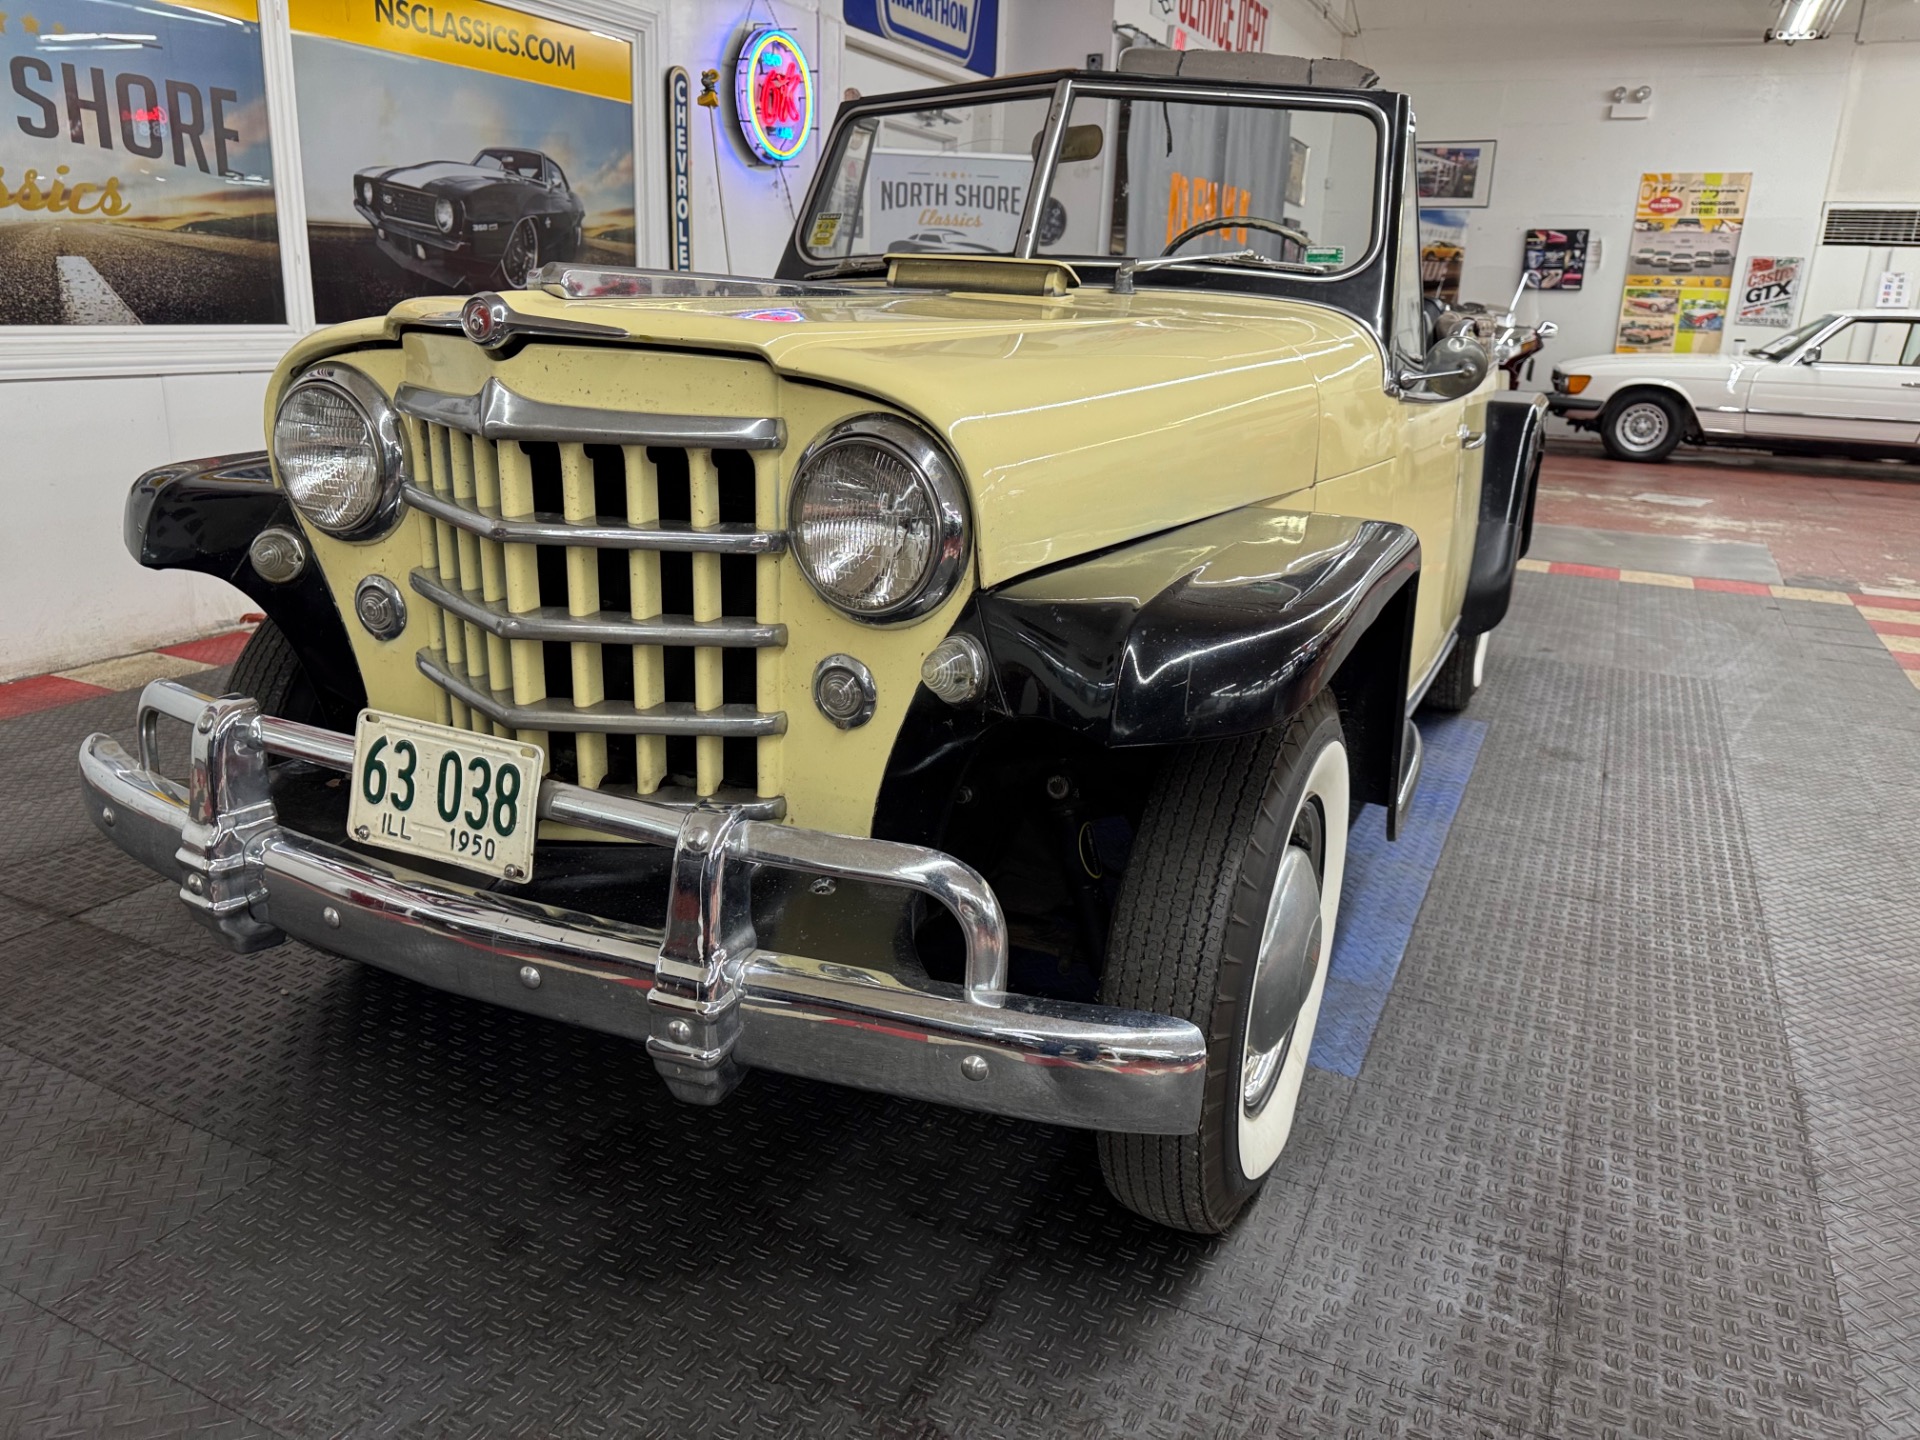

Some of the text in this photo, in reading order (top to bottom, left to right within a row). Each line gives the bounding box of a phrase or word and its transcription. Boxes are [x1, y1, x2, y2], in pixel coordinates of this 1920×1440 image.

[892, 0, 968, 34] RATHON
[375, 0, 576, 70] NSCLASSICS.COM
[10, 56, 241, 178] SHORE
[675, 80, 689, 271] CHEVROLE
[881, 180, 1021, 216] NORTH SHORE
[918, 208, 984, 228] Classics
[1746, 279, 1793, 303] GTX
[1748, 266, 1797, 287] Castro
[363, 735, 521, 837] 63 038
[381, 813, 412, 841] ILL
[450, 828, 496, 861] 1950
